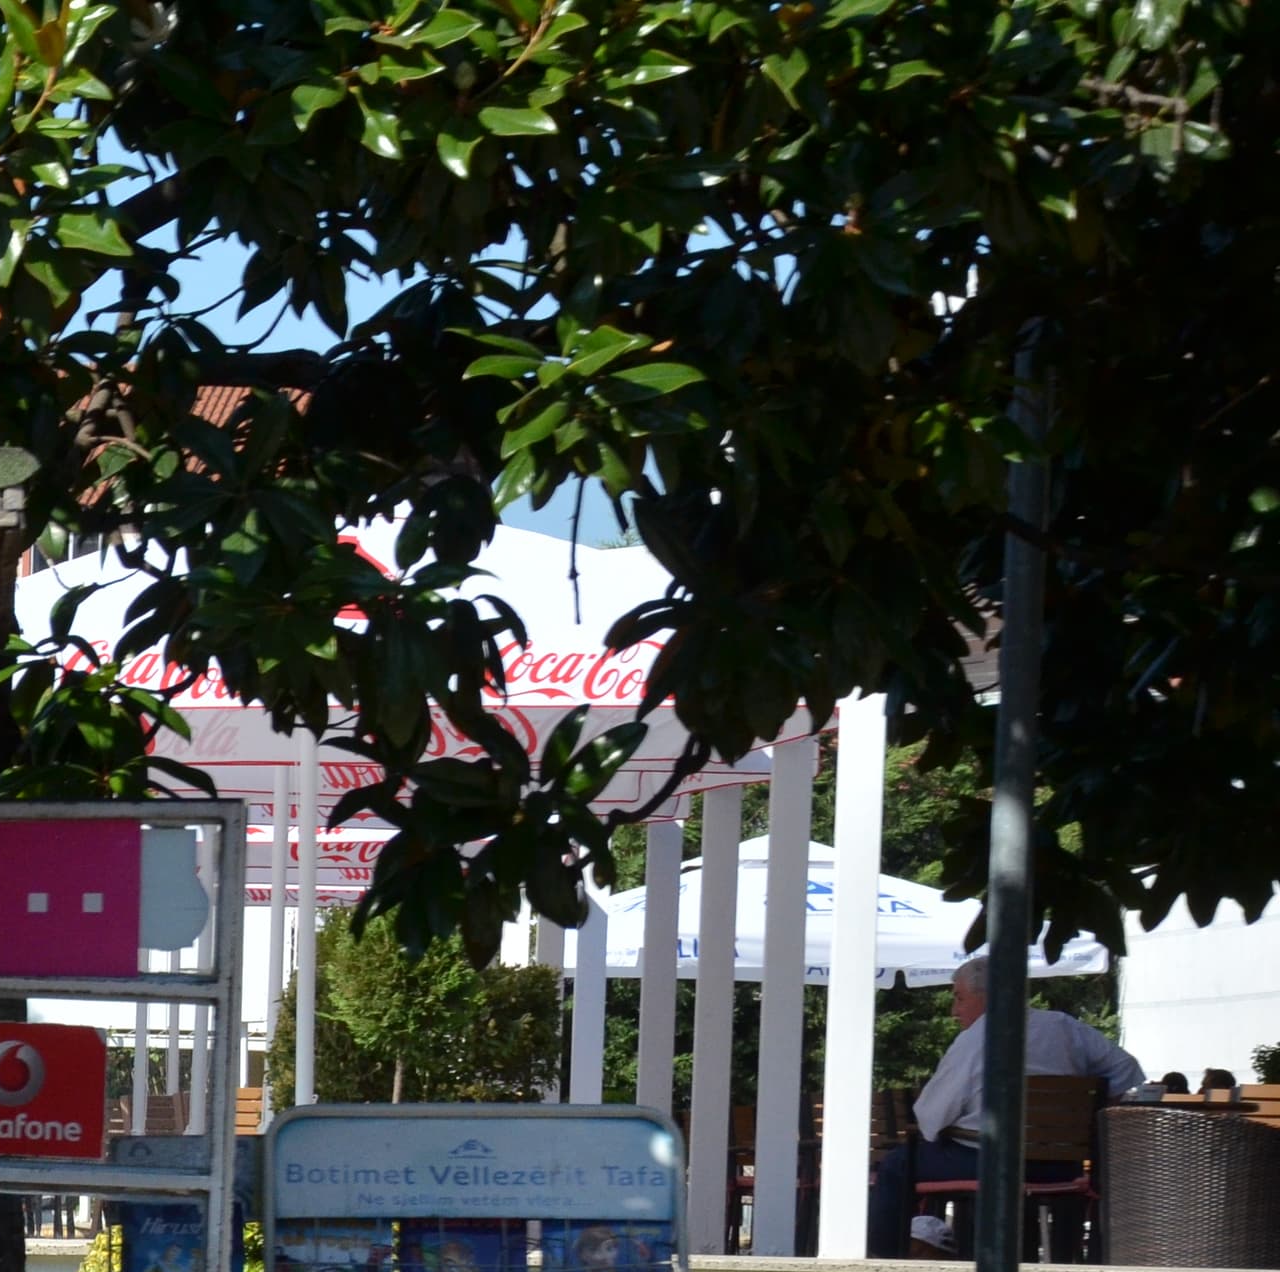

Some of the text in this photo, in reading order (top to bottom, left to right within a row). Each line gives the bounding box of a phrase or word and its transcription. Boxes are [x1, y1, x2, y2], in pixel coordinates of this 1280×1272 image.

[482, 639, 674, 700] Coca-Co
[286, 1163, 416, 1185] Botimet
[600, 1164, 666, 1187] Tafa
